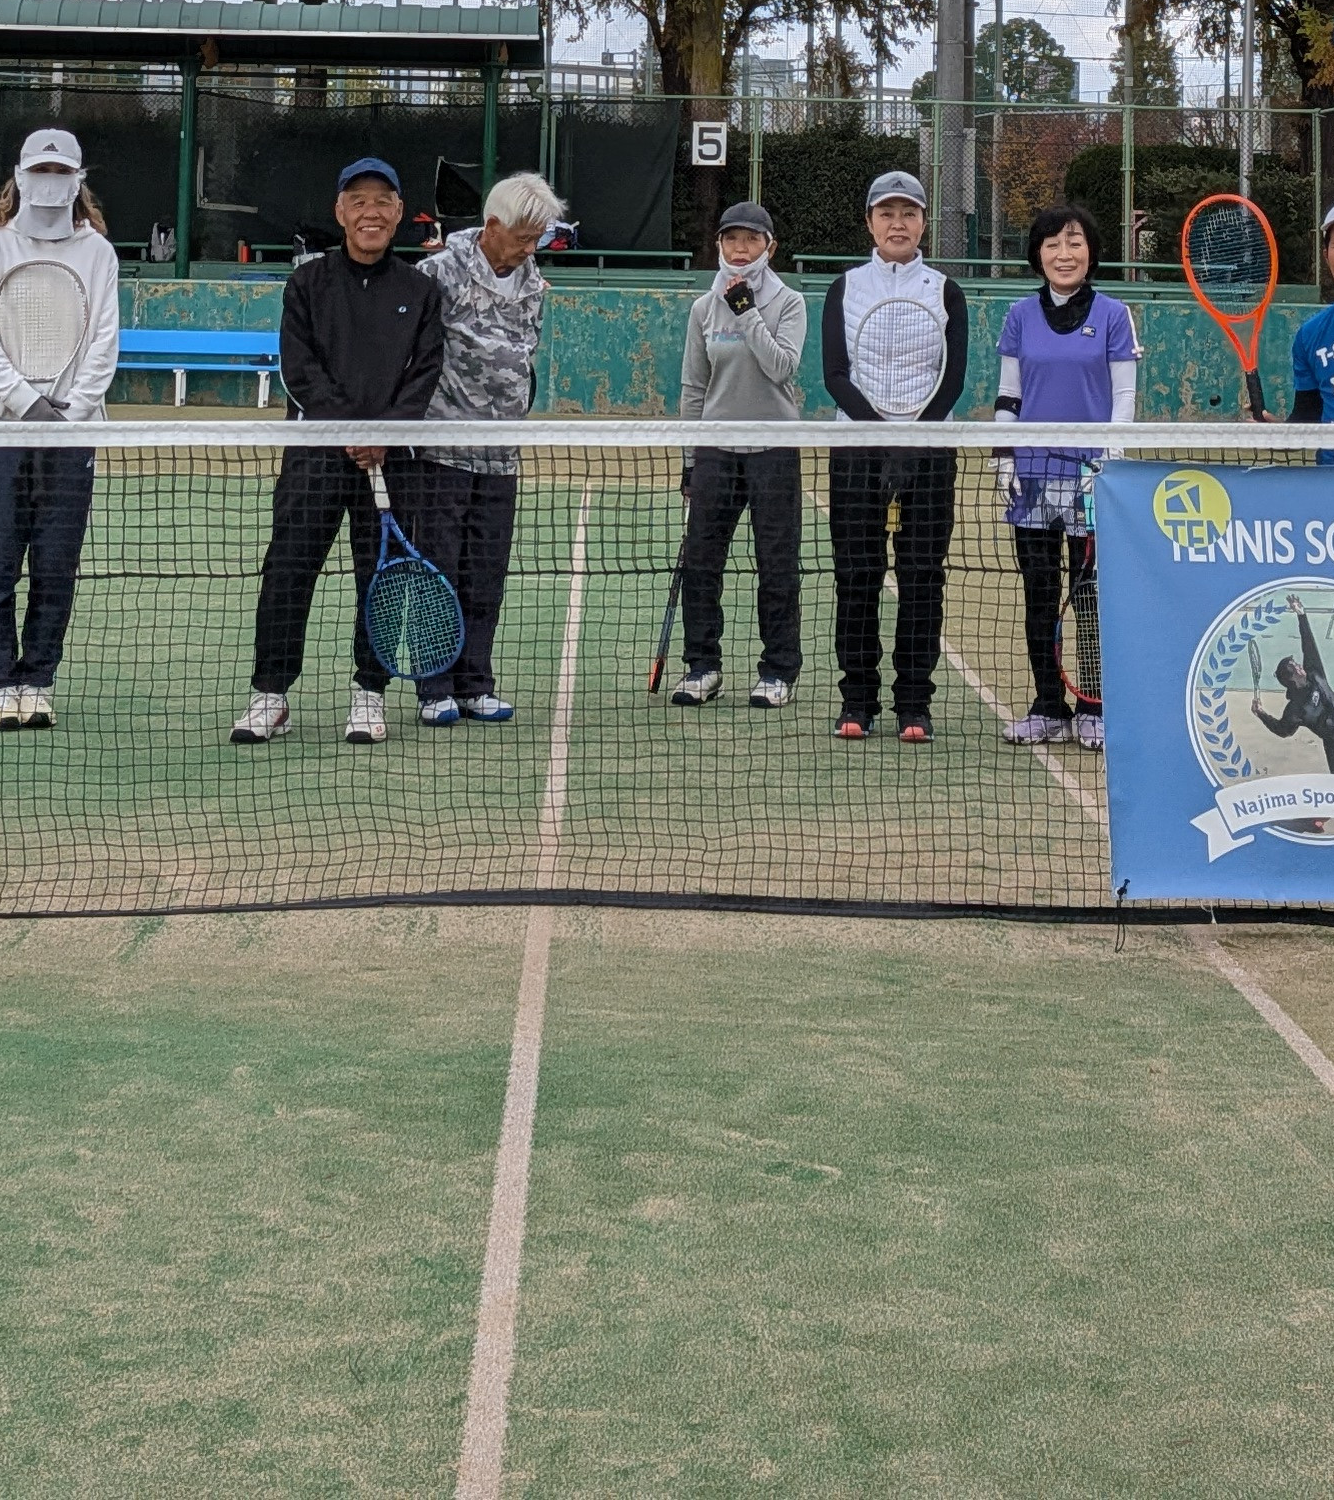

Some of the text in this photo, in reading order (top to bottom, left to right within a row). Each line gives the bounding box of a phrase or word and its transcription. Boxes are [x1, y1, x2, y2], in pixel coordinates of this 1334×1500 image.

[698, 126, 722, 160] 5
[1164, 519, 1295, 564] TENNIS
[1233, 793, 1297, 818] Najima
